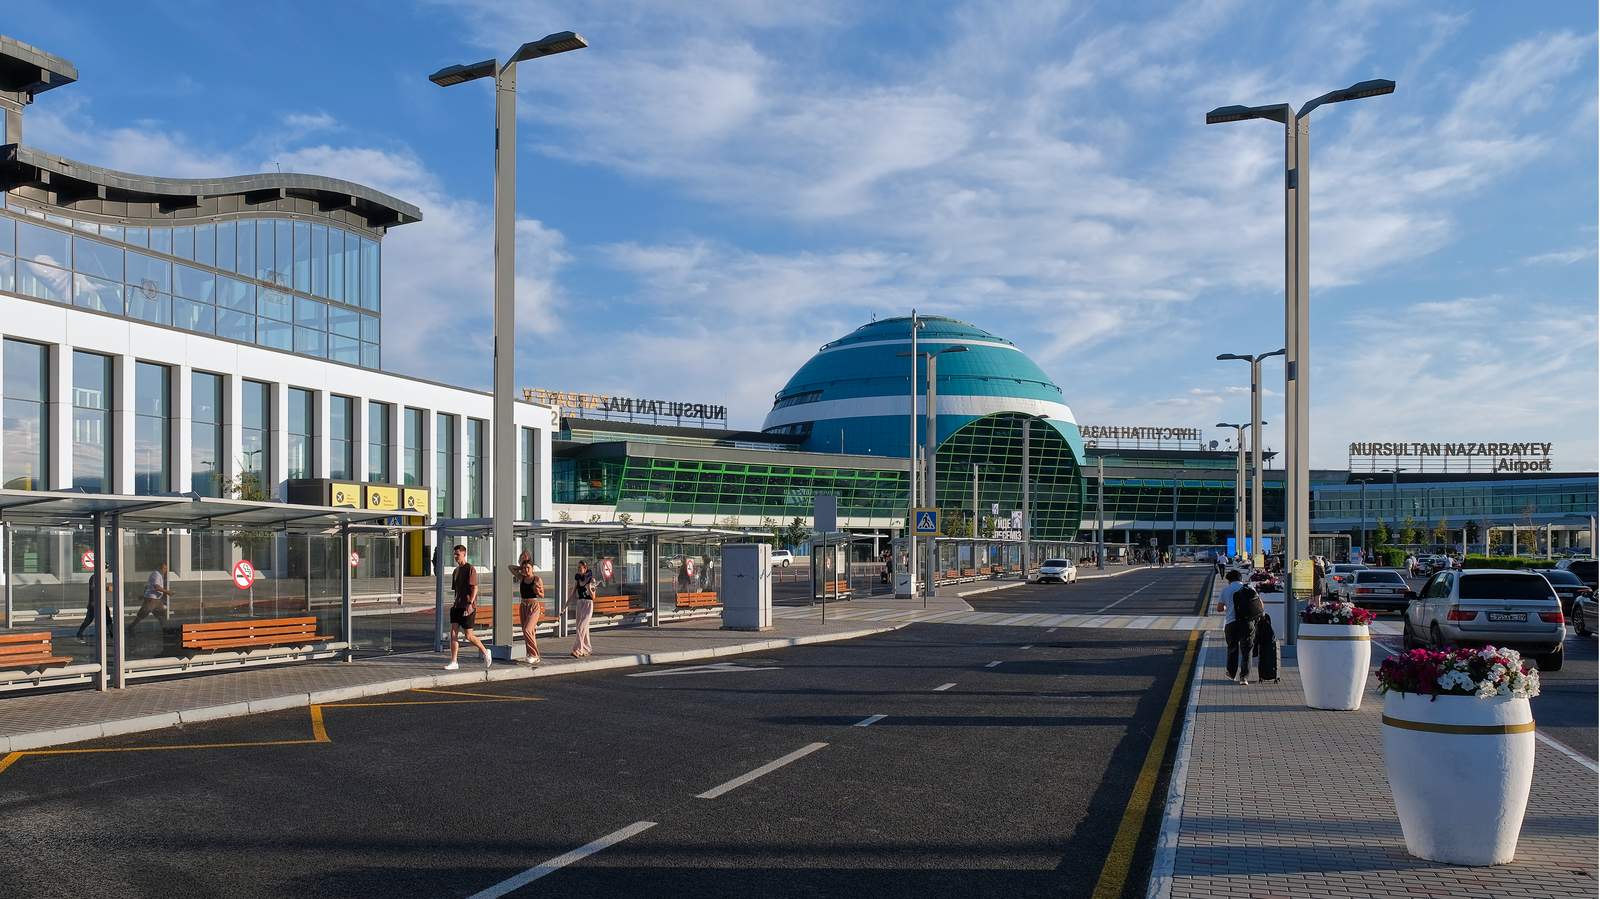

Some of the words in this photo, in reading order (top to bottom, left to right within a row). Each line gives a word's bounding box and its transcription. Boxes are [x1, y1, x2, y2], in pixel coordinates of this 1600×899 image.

[1351, 442, 1441, 456] NURSULTAN
[1445, 442, 1551, 456] NAZARBAYEV
[1497, 457, 1551, 473] Airport
